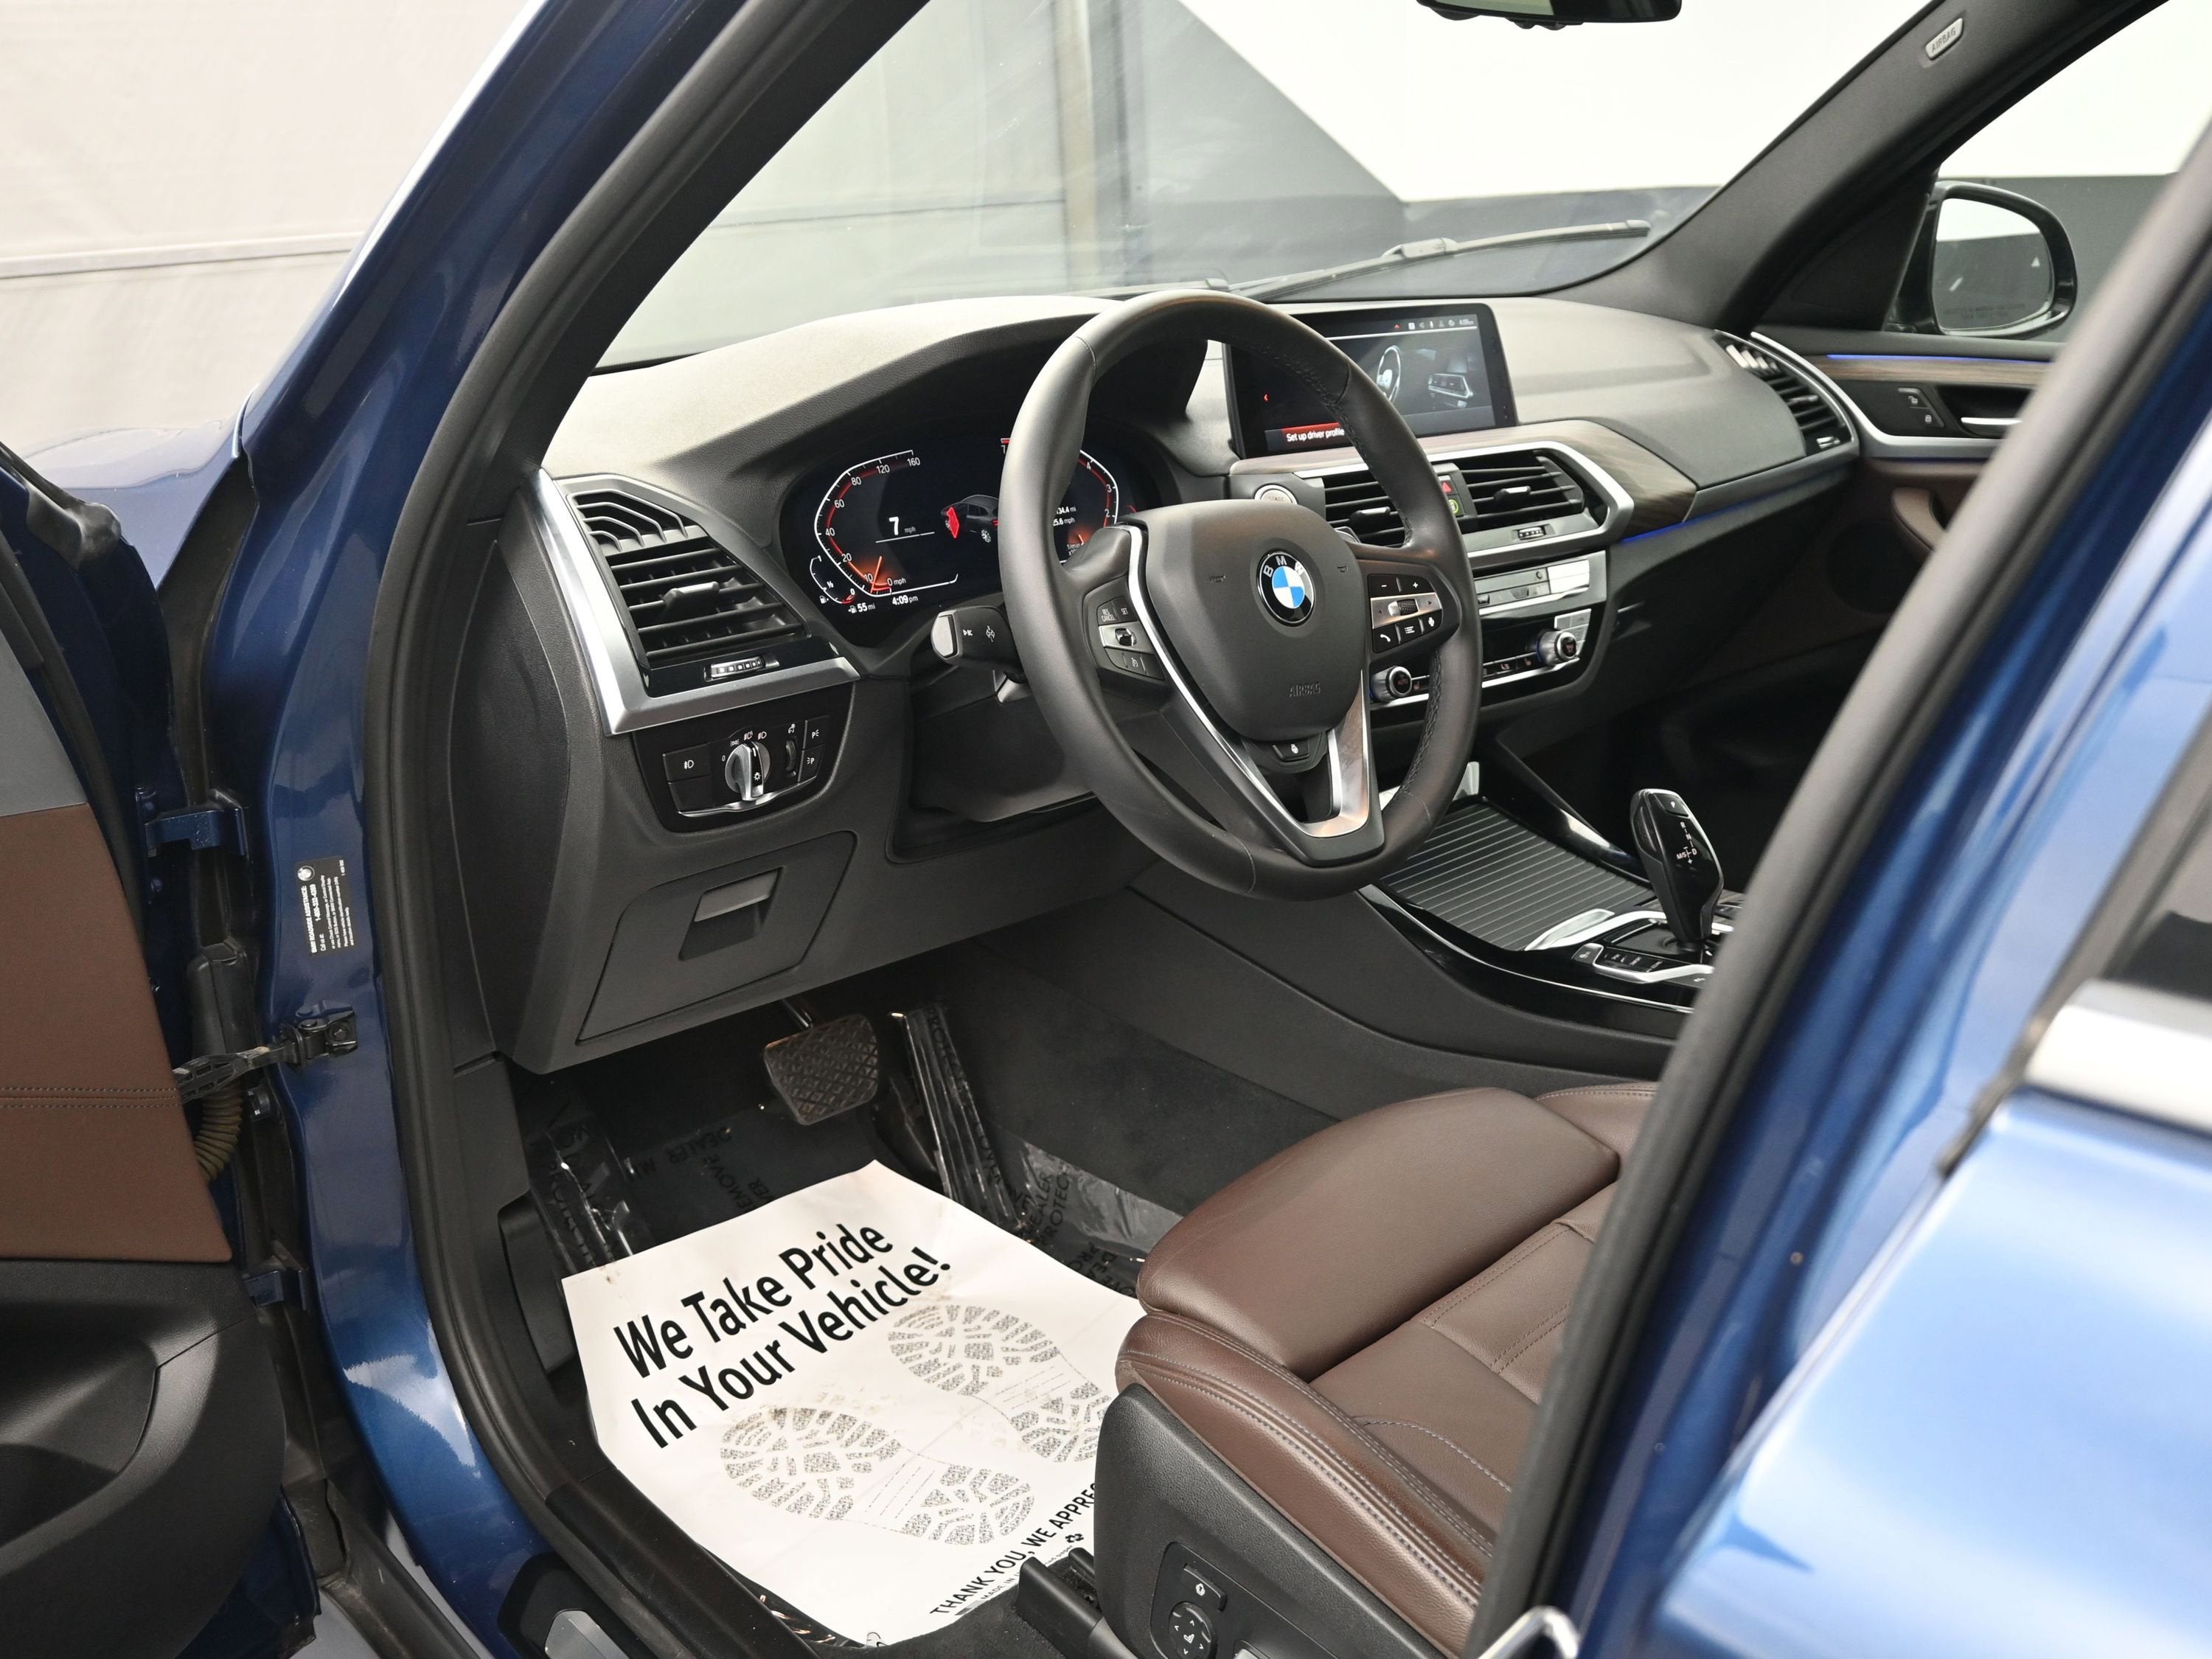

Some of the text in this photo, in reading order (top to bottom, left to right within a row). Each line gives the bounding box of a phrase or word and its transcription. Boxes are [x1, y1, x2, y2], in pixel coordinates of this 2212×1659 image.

[1932, 27, 1956, 53] AIRBAG
[1286, 428, 1345, 442] Set up driver profile
[907, 457, 921, 467] 160
[1086, 462, 1091, 470] 4
[876, 465, 890, 474] 120
[851, 476, 861, 486] 80
[1106, 484, 1112, 493] 3
[834, 499, 845, 508] 60
[1105, 509, 1110, 518] 2
[888, 516, 900, 535] 7
[825, 527, 835, 536] 40
[841, 553, 852, 562] 20
[1263, 555, 1305, 577] BMW
[864, 573, 873, 582] 10
[887, 578, 893, 586] 0
[891, 595, 908, 605] 4:09
[857, 602, 868, 613] 55
[1290, 682, 1321, 698] AIRBAG
[613, 1223, 893, 1379] We Take Pride
[631, 1246, 950, 1449] In Your Vehicle!
[930, 1576, 995, 1615] THANK
[984, 1550, 1035, 1574] YOU,
[1020, 1528, 1057, 1547] WE
